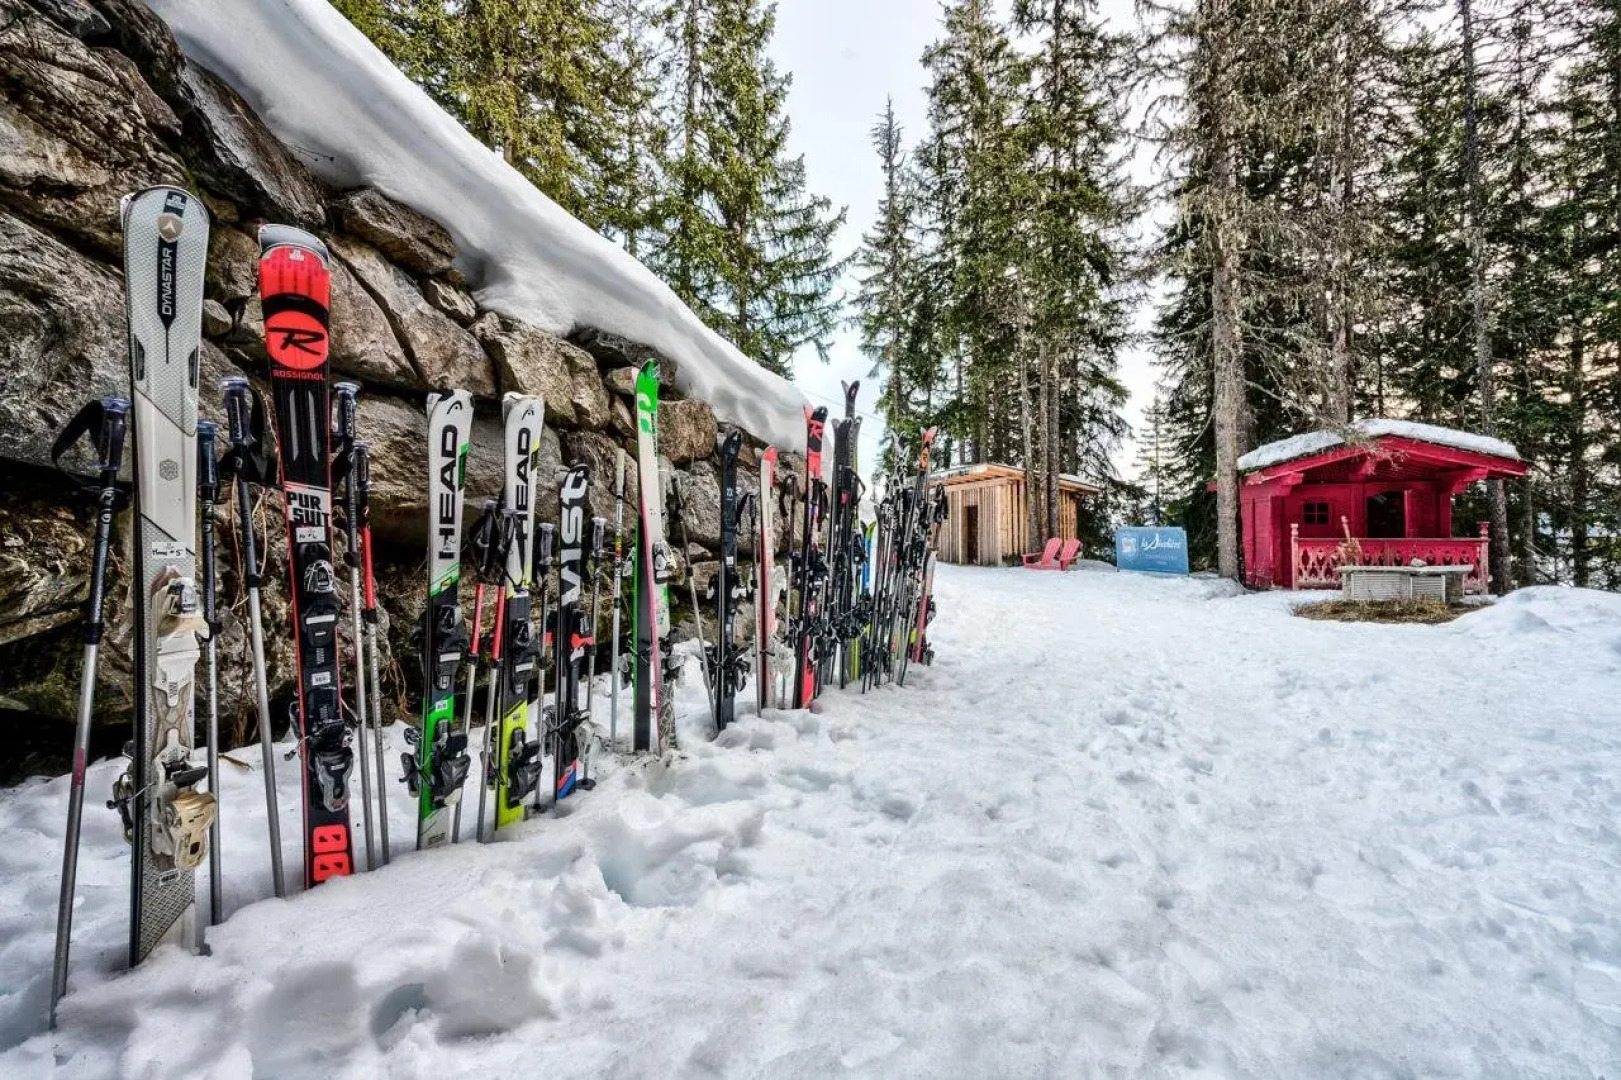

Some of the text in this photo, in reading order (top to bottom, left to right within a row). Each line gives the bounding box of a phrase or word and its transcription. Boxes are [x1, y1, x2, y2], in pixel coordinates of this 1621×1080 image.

[161, 246, 173, 316] DYNASTAR
[272, 369, 324, 381] ROSSIGNOL
[286, 491, 322, 510] PUR
[438, 423, 458, 560] HEAD
[292, 507, 330, 527] SUIT
